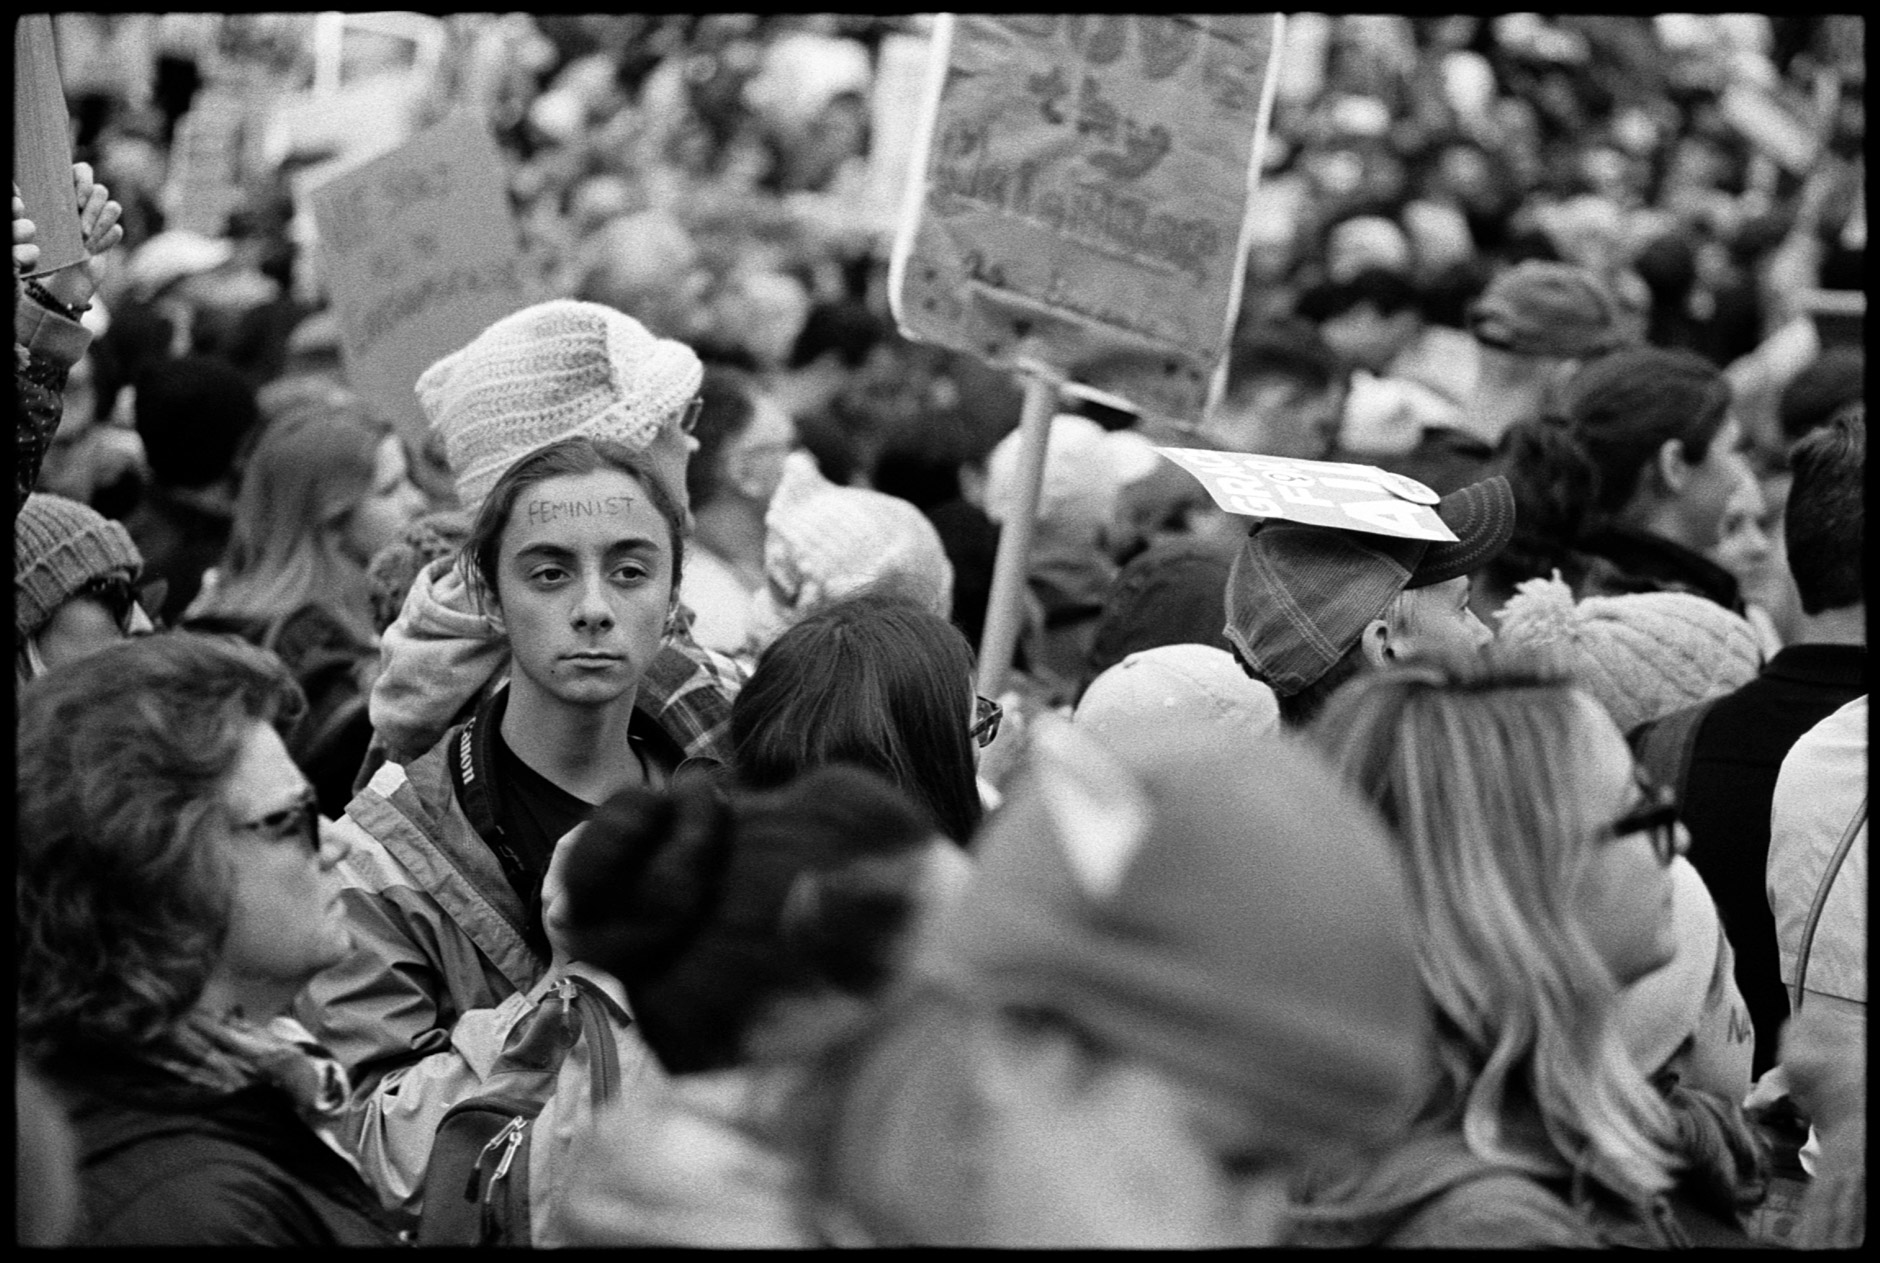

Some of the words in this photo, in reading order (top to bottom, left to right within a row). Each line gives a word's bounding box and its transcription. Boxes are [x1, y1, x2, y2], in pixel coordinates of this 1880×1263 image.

[1242, 459, 1336, 508] FOR
[528, 496, 634, 525] FEMINIST
[460, 716, 475, 785] Canon
